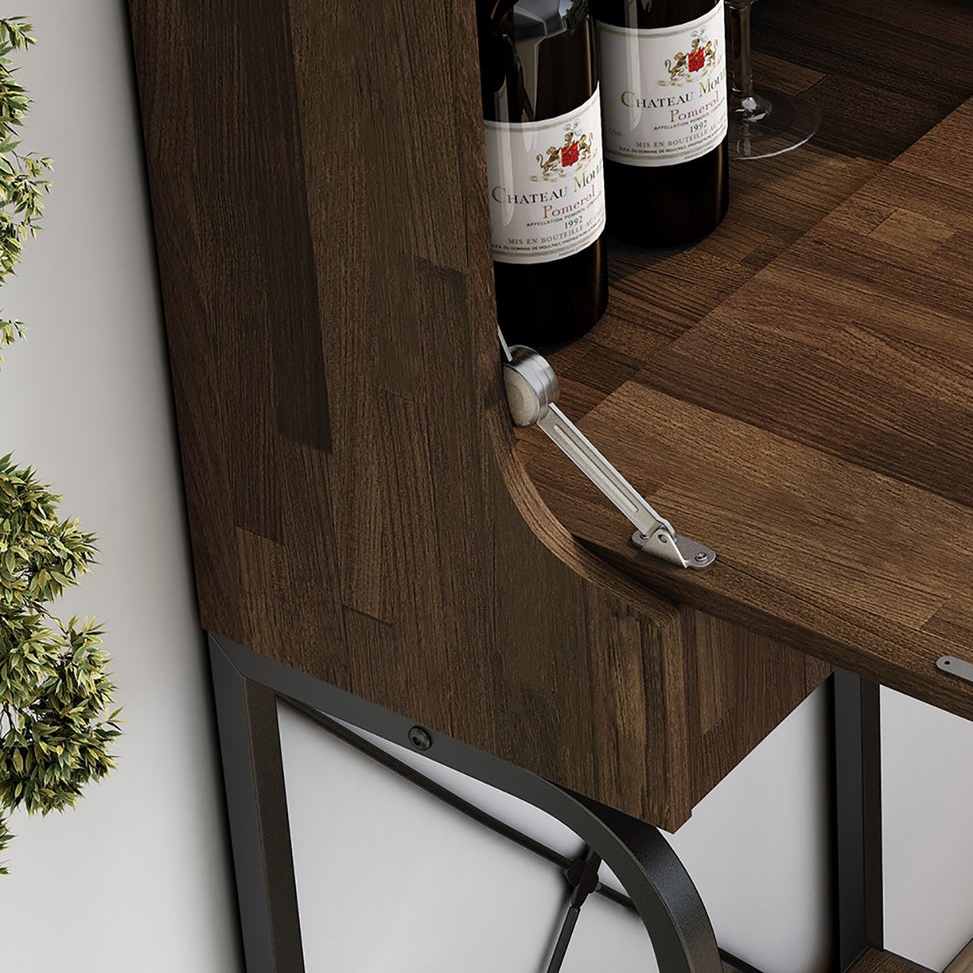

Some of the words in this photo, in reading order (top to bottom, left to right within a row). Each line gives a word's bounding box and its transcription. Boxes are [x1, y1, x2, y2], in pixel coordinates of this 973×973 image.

[670, 90, 719, 123] Pomerol
[690, 119, 708, 133] 1992
[667, 130, 708, 146] BOUTEILLE
[492, 186, 568, 204] CHATEAU
[543, 184, 596, 219] Pomerol
[564, 215, 583, 230] 1992
[541, 226, 584, 244] BOUTEILLE
